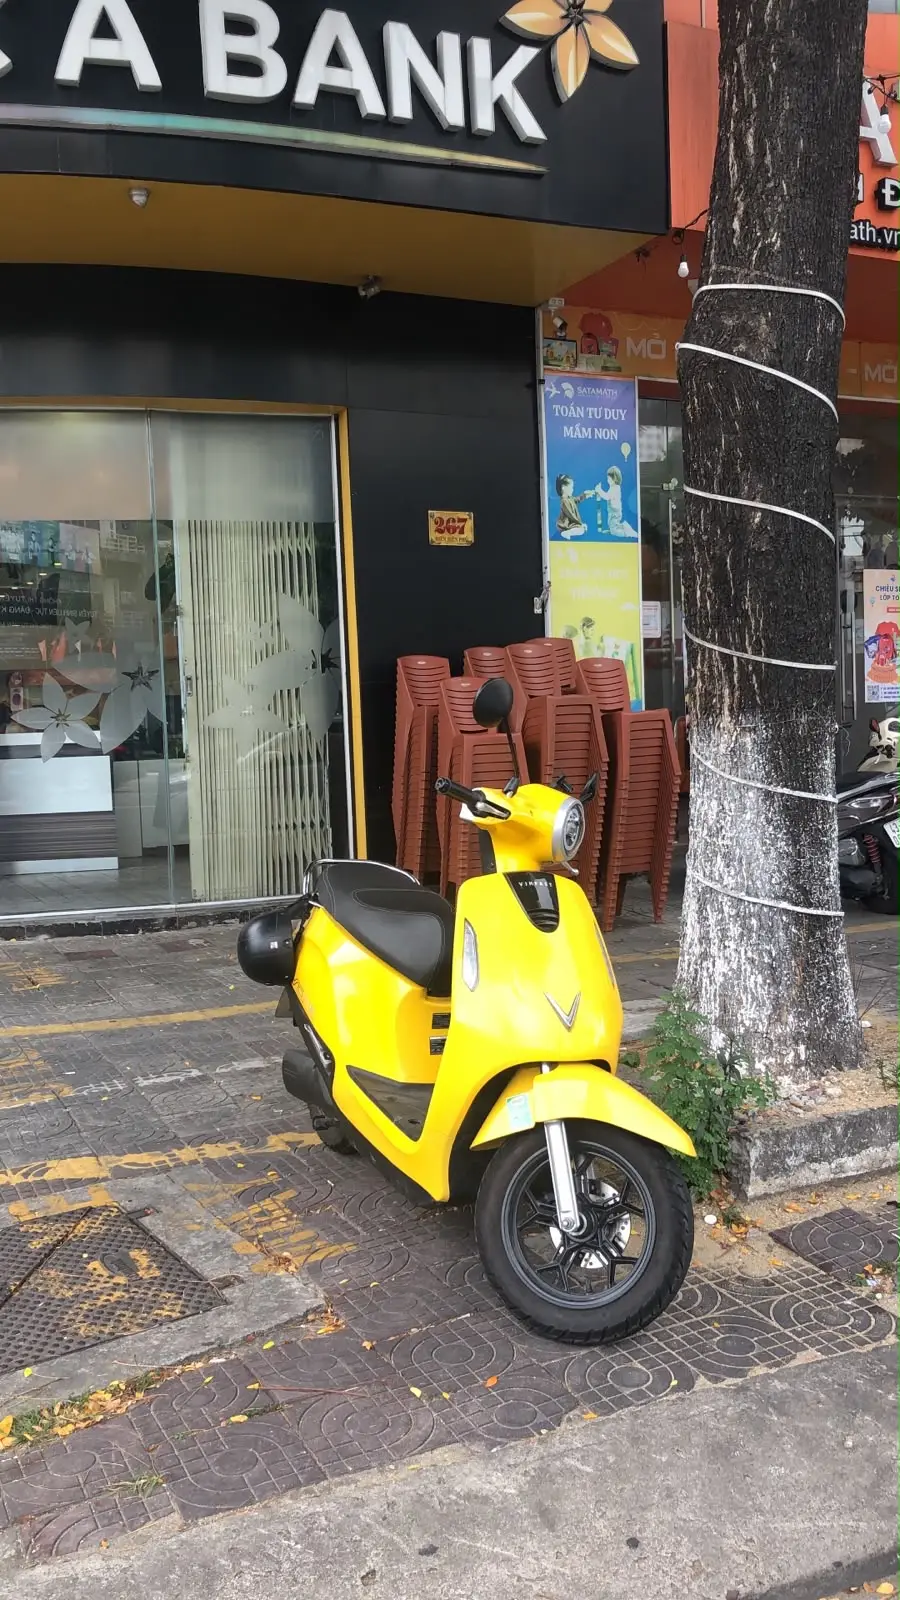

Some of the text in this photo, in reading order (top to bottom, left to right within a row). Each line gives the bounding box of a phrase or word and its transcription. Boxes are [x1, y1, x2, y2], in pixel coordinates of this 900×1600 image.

[54, 0, 163, 93] A
[199, 0, 548, 145] BANK
[577, 386, 618, 397] SATAMATH
[552, 402, 627, 421] TOÁN TƯ DUY
[594, 428, 618, 441] NON
[434, 516, 468, 535] 267
